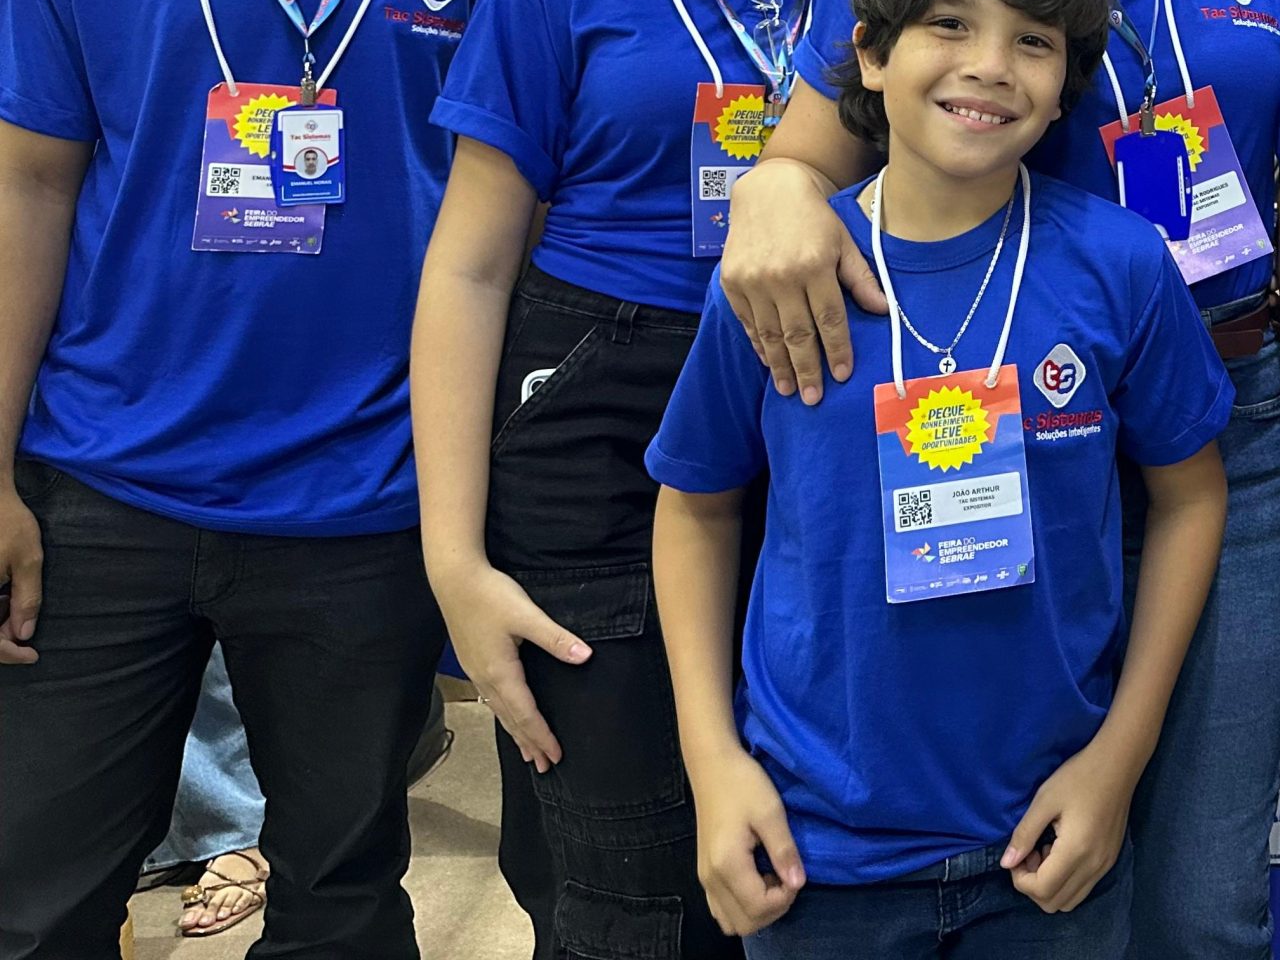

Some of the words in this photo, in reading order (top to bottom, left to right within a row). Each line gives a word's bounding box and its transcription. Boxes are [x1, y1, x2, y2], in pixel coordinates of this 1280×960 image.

[384, 7, 409, 21] Tac
[1201, 8, 1227, 19] Tac
[735, 126, 758, 134] LEVE
[935, 425, 962, 440] LEVE
[1036, 428, 1067, 441] Soluções
[952, 489, 970, 498] JOÃO
[972, 485, 1000, 495] ARTHUR
[938, 539, 962, 549] FEIRA
[963, 537, 975, 546] DO
[938, 539, 1008, 556] EMPREENDEDOR
[940, 551, 975, 564] SEBRAE
